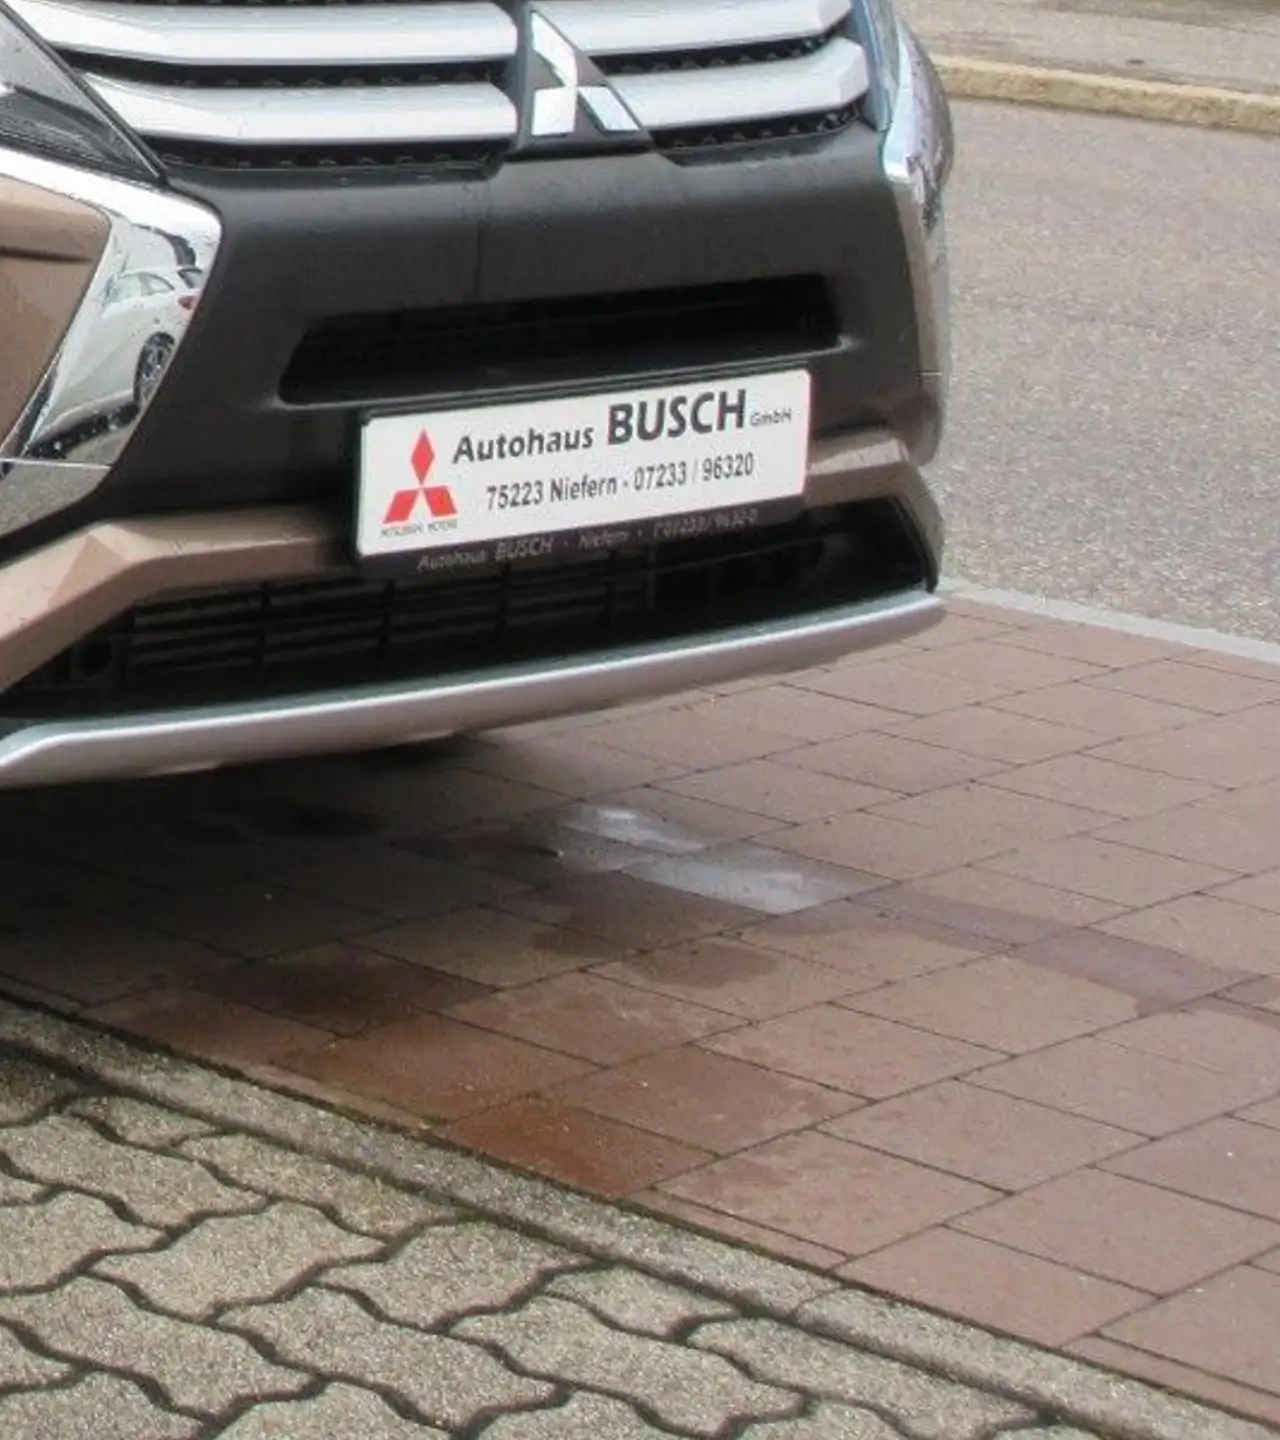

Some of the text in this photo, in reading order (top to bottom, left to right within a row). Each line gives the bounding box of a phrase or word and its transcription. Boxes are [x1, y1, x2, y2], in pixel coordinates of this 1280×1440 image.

[452, 389, 792, 464] Autohaus BUSCH GmbH
[486, 479, 544, 511] 75223
[550, 473, 618, 503] Niefern
[634, 461, 688, 492] 07233
[702, 451, 755, 482] 96320
[495, 536, 554, 561] BUSCH
